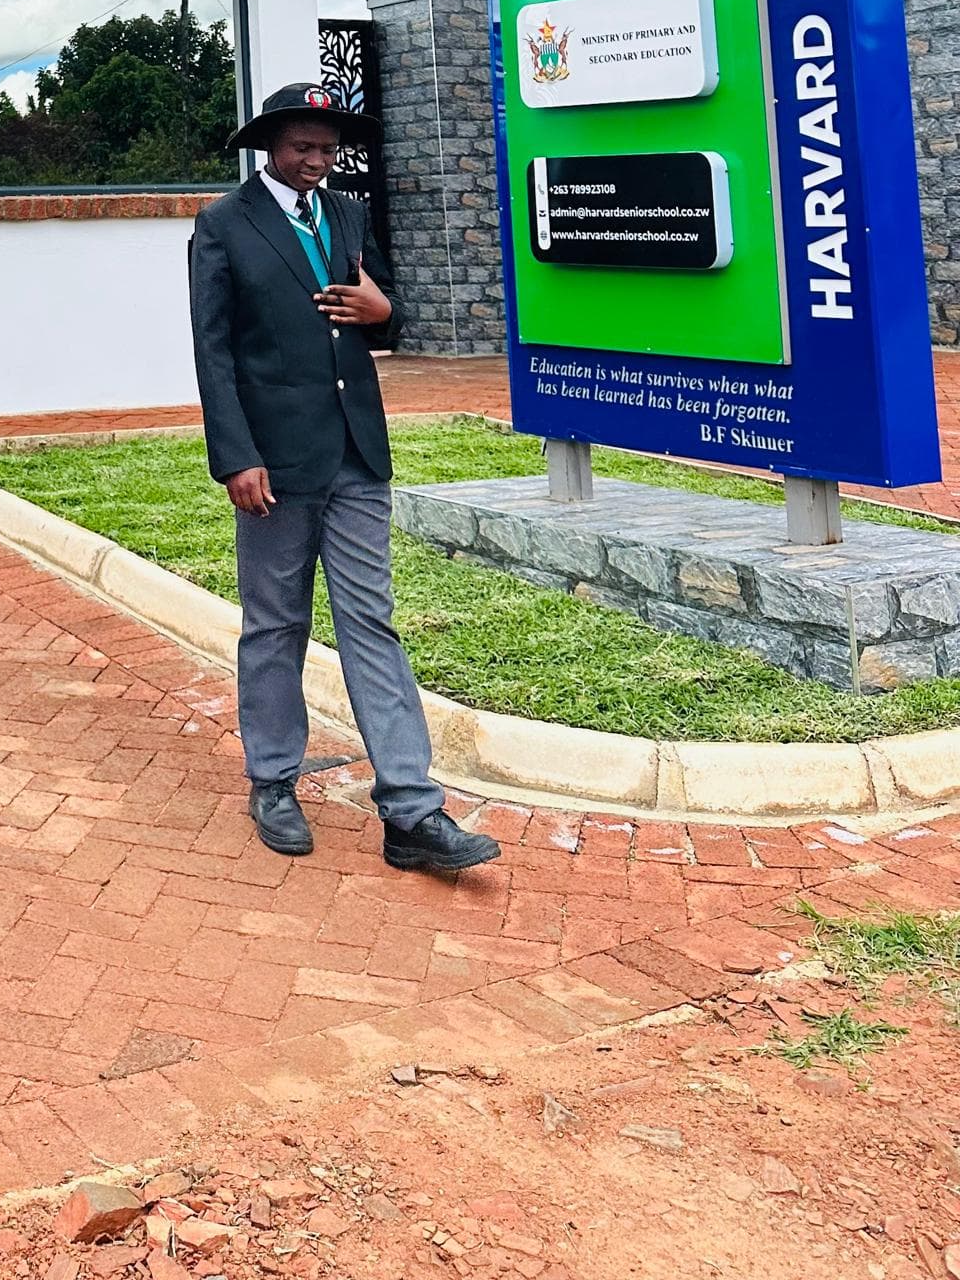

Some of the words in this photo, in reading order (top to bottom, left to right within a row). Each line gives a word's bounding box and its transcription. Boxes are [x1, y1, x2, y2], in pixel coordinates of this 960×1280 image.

[581, 32, 620, 46] MINISTRY
[622, 31, 634, 41] OF
[635, 26, 676, 39] PRIMARY
[676, 24, 696, 35] AND
[589, 50, 639, 65] SECONDARY
[640, 46, 692, 60] EDUCATION
[791, 14, 854, 321] HARVARD
[549, 184, 569, 195] +263
[569, 184, 616, 195] 789923108
[550, 206, 710, 219] admin@harvardseniorschool.co.zw
[551, 230, 699, 242] www.harvardseniorschool.co.zw
[529, 356, 591, 379] Education
[596, 363, 607, 381] is
[610, 366, 642, 385] what
[646, 371, 704, 391] survives
[708, 375, 749, 396] when
[754, 380, 794, 400] what
[536, 378, 558, 395] has
[561, 380, 590, 400] been
[594, 384, 644, 407] learned
[648, 391, 672, 410] has
[677, 394, 711, 415] been
[712, 398, 791, 424] forgotten.
[700, 423, 727, 444] B.F
[730, 427, 795, 453] Skinner
